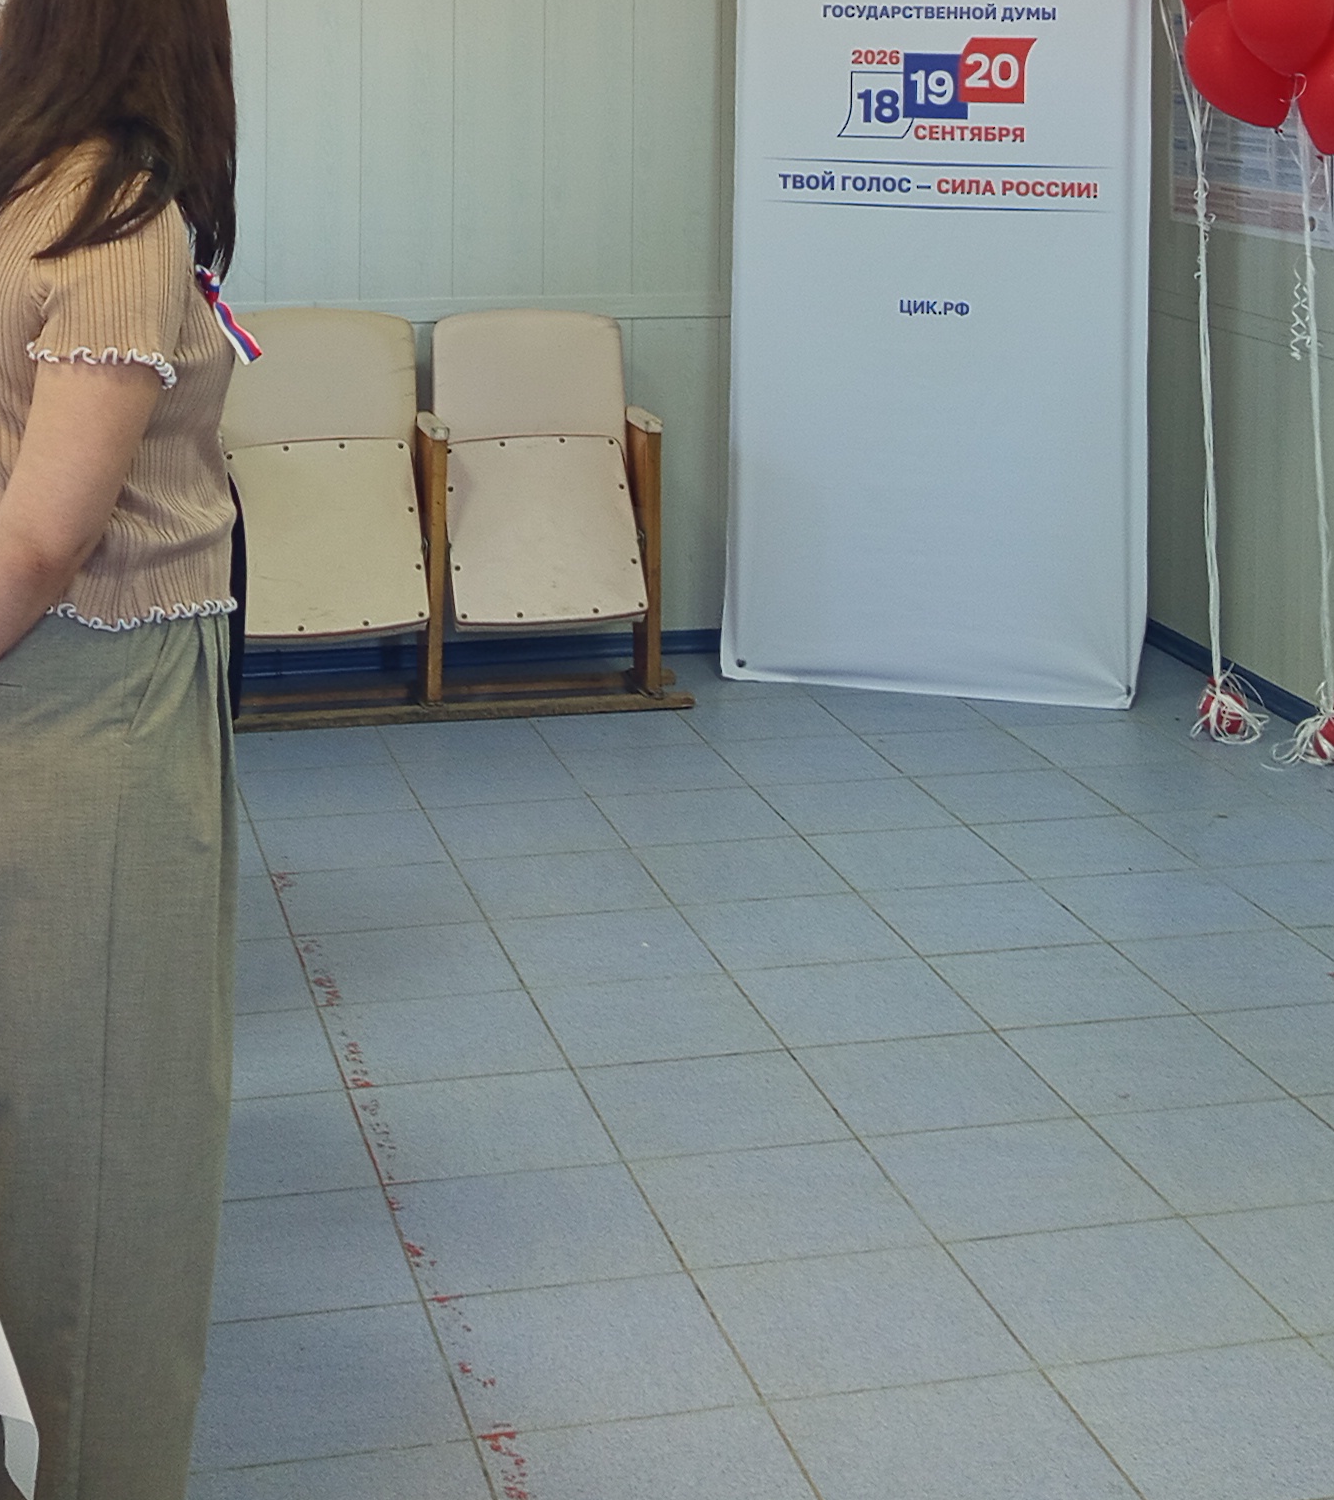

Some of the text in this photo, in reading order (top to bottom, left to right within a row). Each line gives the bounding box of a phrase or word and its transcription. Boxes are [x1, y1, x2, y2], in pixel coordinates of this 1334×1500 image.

[822, 4, 1057, 22] ГОСУДАРСТВЕННОЙ ДУМЫ
[851, 49, 900, 65] 2026
[857, 53, 1019, 123] 18 19 20
[914, 125, 1025, 142] СЕНТЯБРЯ
[779, 171, 835, 191] ТВОЙ
[841, 175, 912, 193] ГОЛОС
[936, 178, 996, 196] СИЛА
[1001, 180, 1099, 199] РОССИИ!
[899, 299, 970, 316] ЦИК.РФ
